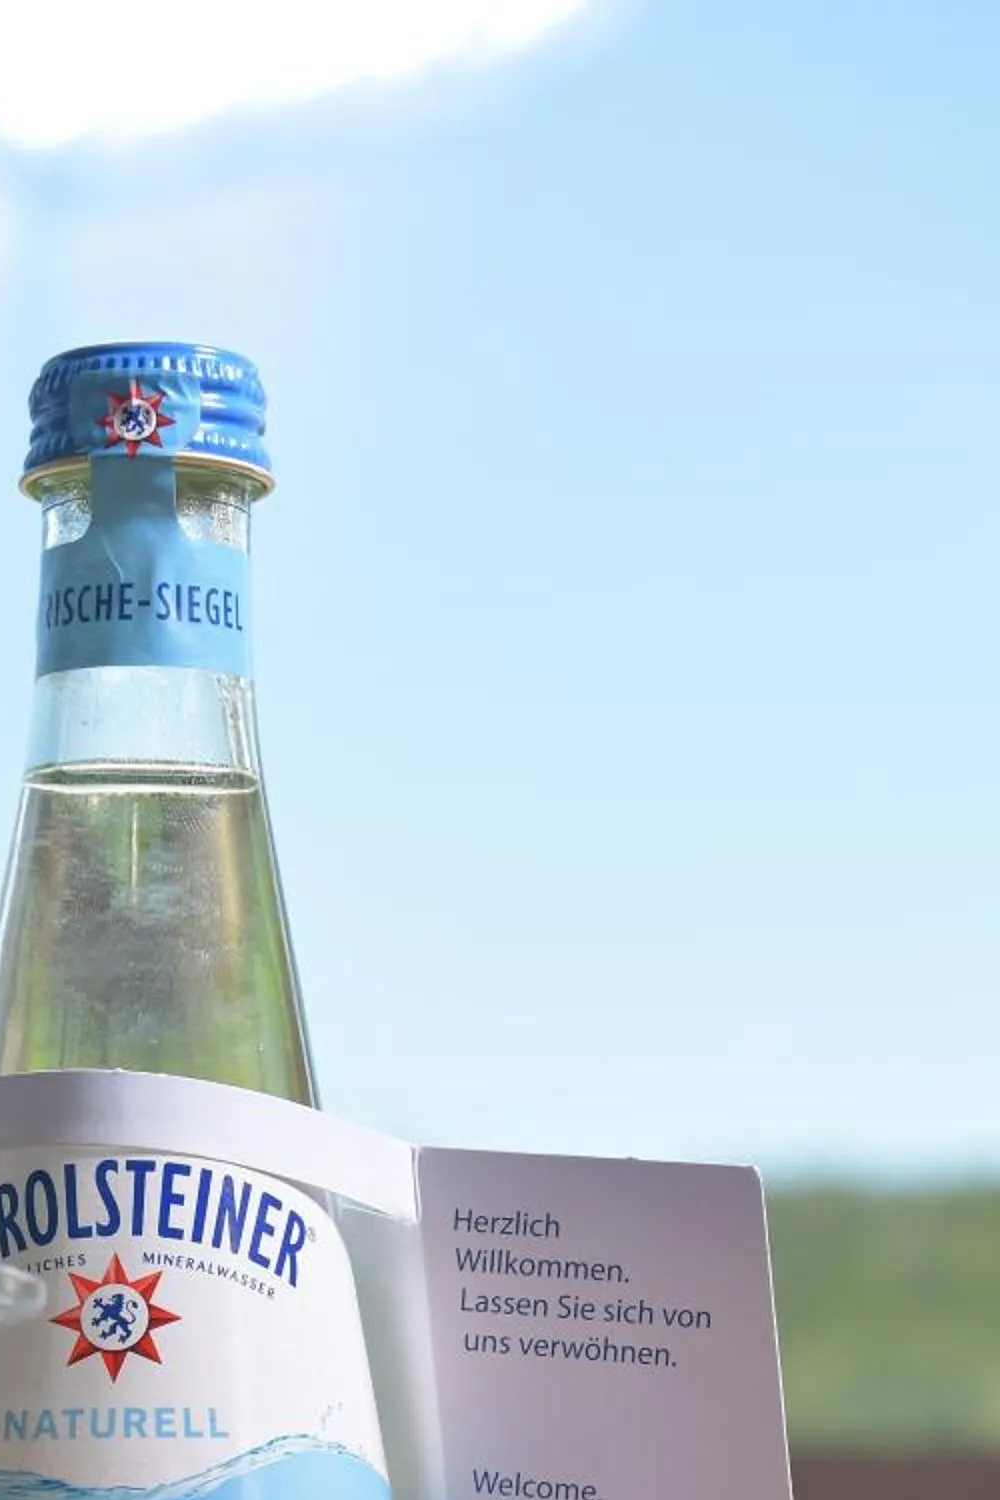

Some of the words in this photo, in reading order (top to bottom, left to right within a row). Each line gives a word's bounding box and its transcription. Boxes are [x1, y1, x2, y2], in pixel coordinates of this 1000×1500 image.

[453, 1208, 560, 1238] Herzlich
[143, 1252, 275, 1298] MINERALWASSER
[456, 1248, 630, 1283] Willkommen.
[460, 1288, 548, 1318] Lassen
[557, 1294, 595, 1321] Sie
[604, 1299, 653, 1325] sich
[664, 1308, 712, 1329] von
[464, 1333, 511, 1355] uns
[520, 1336, 677, 1367] verwöhnen.
[4, 1408, 229, 1441] NATURELL
